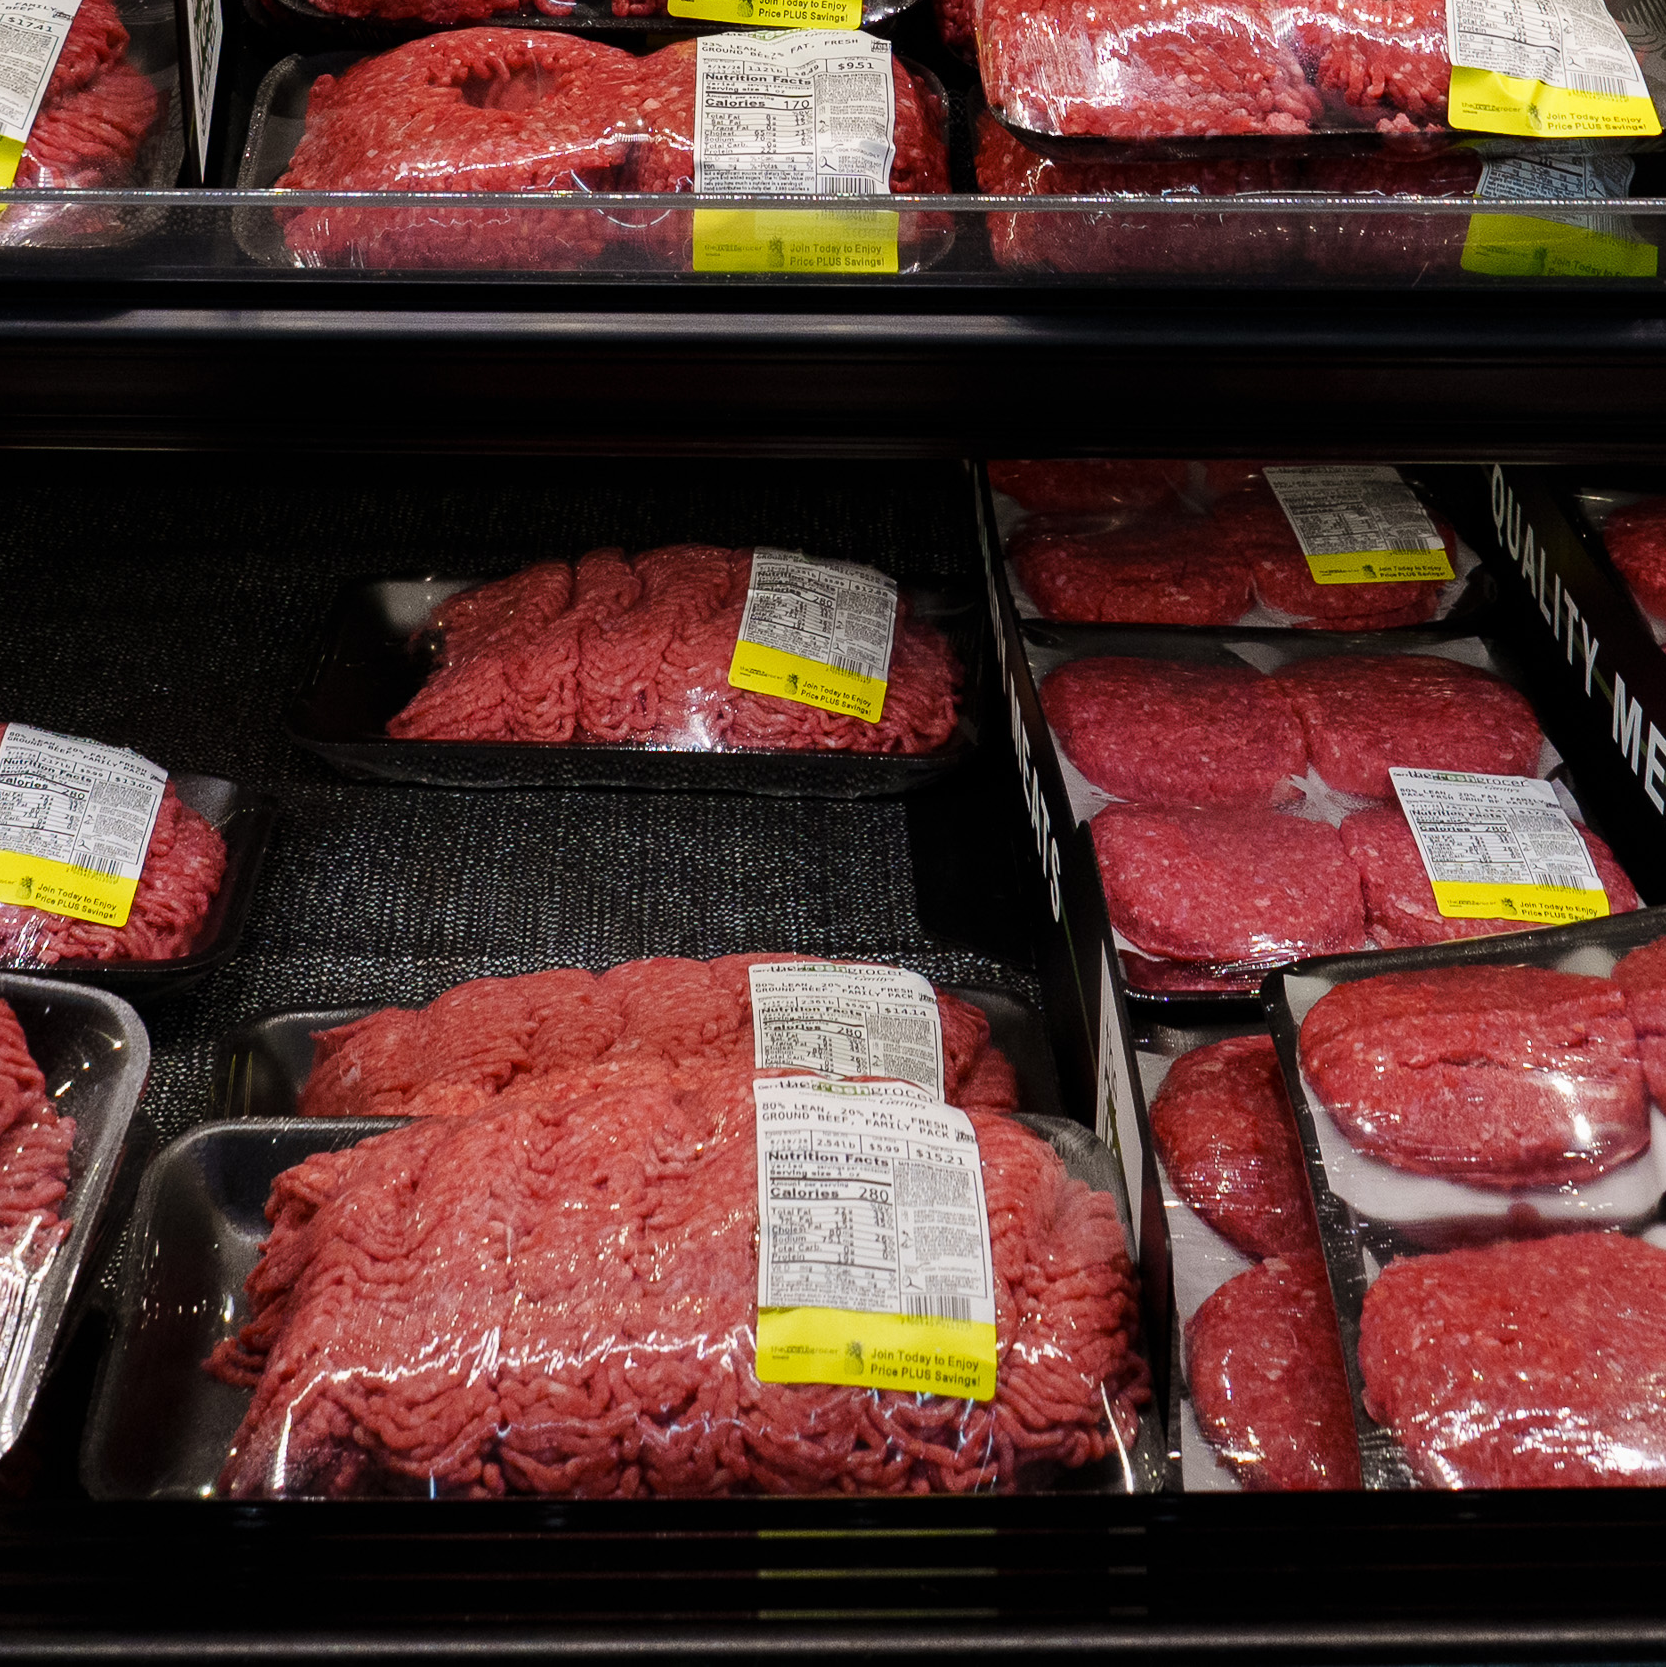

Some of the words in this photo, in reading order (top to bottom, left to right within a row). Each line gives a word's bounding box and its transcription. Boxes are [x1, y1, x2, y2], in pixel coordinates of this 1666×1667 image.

[758, 8, 781, 19] Price
[783, 10, 808, 20] PLUS
[810, 11, 848, 23] Savings!
[811, 0, 819, 8] to
[821, 0, 847, 12] Enjoy
[1492, 463, 1599, 698] QUALITY
[762, 1112, 810, 1122] GROUND
[817, 1114, 854, 1126] BEEF,
[865, 1118, 911, 1132] FAMILY
[919, 1127, 949, 1140] PACK
[768, 1152, 839, 1163] Nutrition
[845, 1154, 889, 1167] Facts
[816, 1139, 856, 1150] 2.54lb
[869, 1142, 900, 1154] $5.99
[916, 1148, 965, 1167] $15.21
[770, 1187, 839, 1199] Calories
[858, 1188, 890, 1204] 280
[871, 1348, 895, 1362] Join
[897, 1350, 932, 1367] Today
[935, 1353, 946, 1366] to
[948, 1355, 979, 1373] Enjoy
[870, 1364, 898, 1378] Price
[901, 1366, 931, 1381] PLUS
[935, 1371, 981, 1388] Savings!
